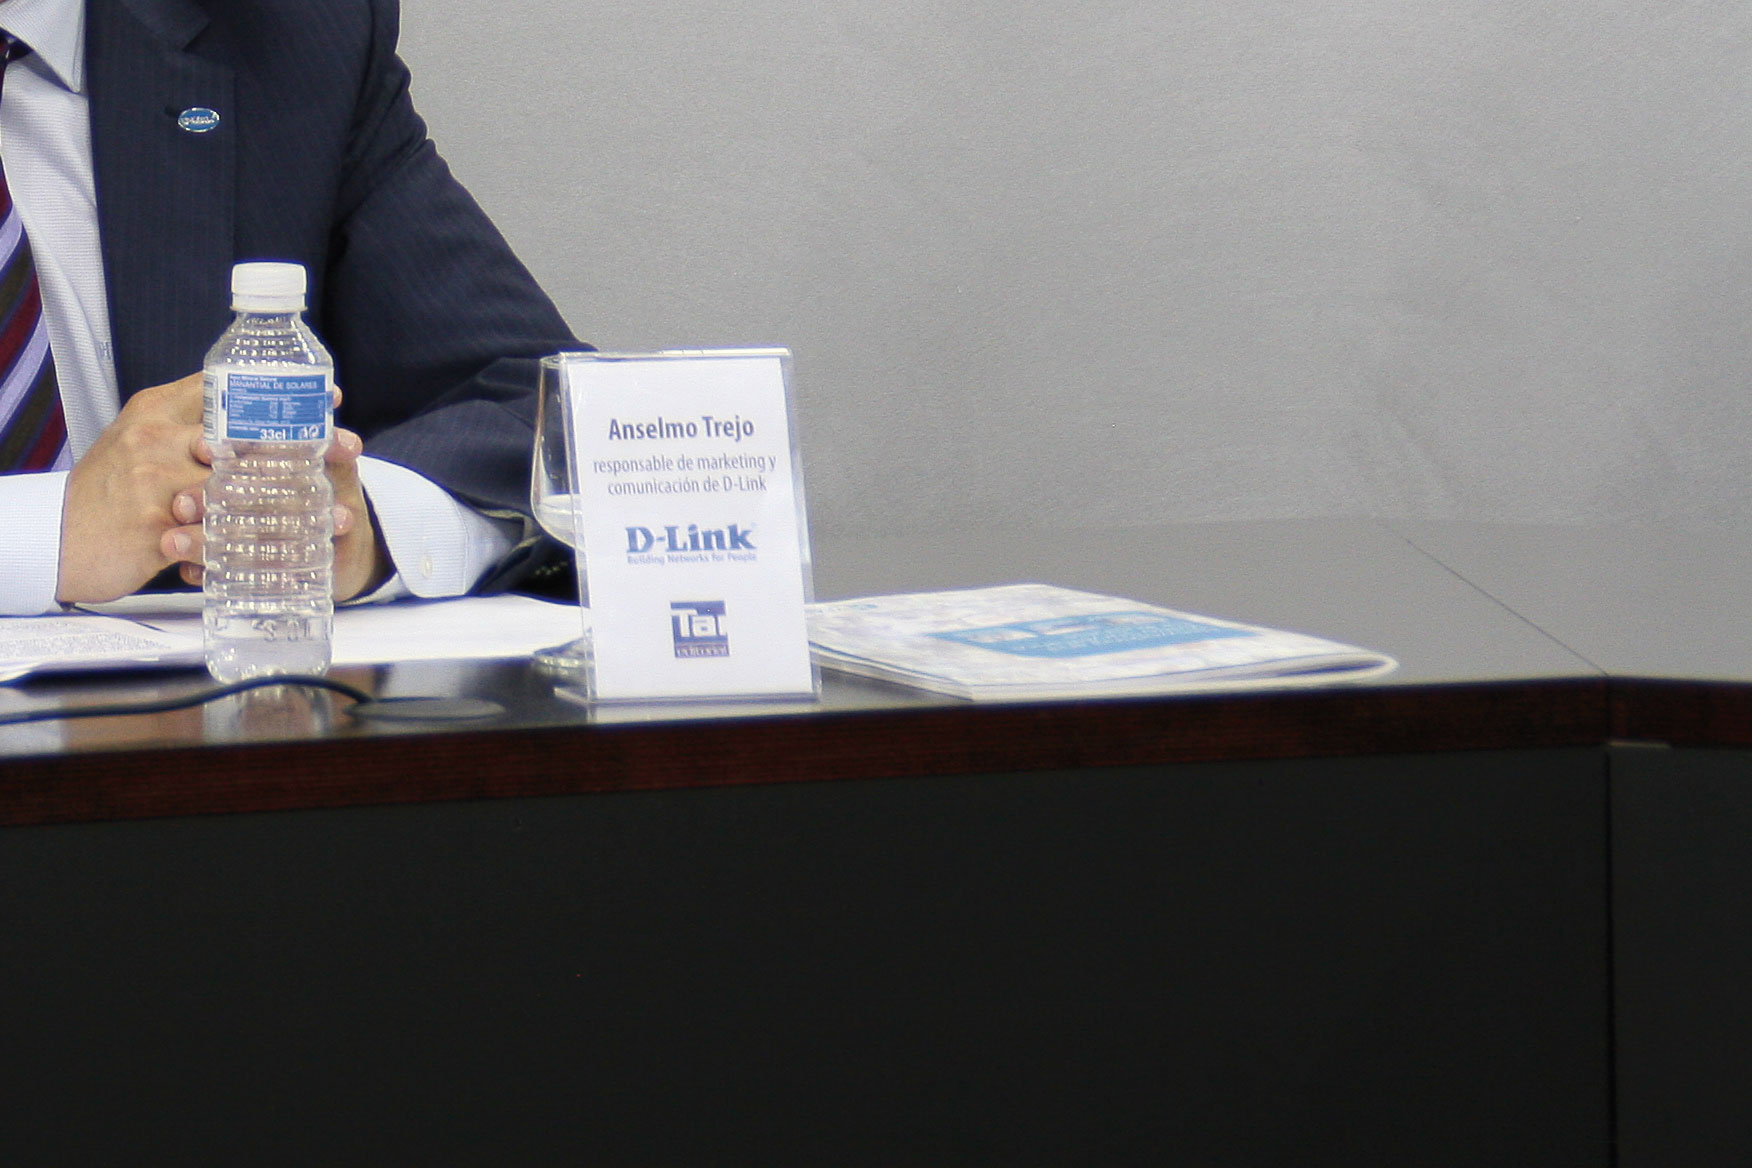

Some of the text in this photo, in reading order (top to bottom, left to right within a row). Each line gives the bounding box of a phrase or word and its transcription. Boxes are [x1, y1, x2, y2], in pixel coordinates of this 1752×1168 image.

[273, 381, 284, 390] DE
[259, 428, 287, 441] 33cl
[608, 414, 755, 443] Anselmo Trejo
[593, 452, 777, 476] responsable de marketing y
[607, 475, 768, 496] comunicación de D-Link
[625, 523, 758, 553] D-Link
